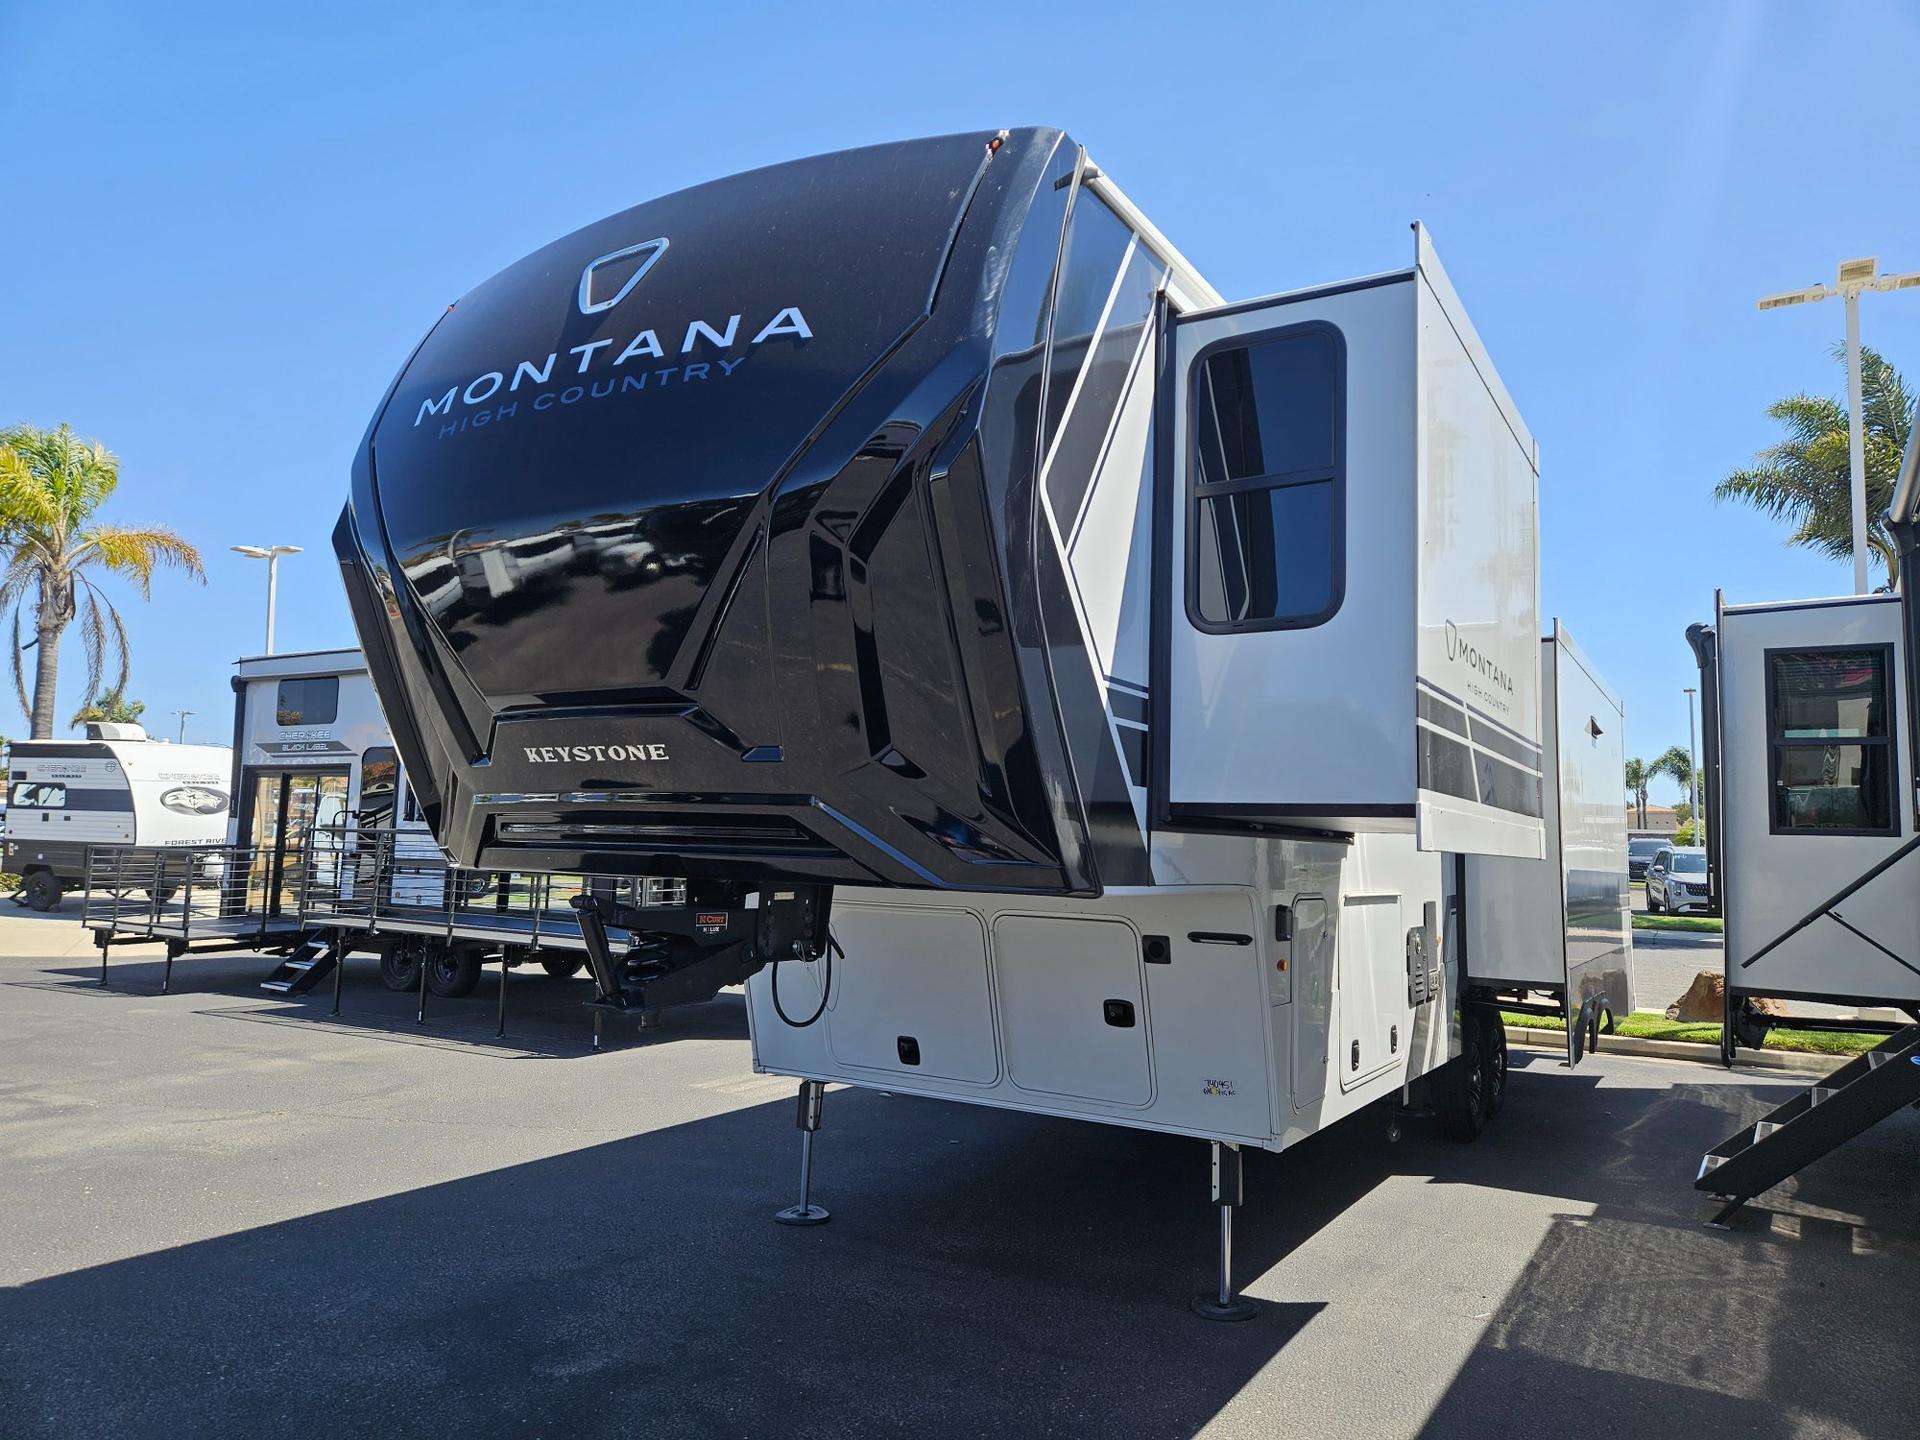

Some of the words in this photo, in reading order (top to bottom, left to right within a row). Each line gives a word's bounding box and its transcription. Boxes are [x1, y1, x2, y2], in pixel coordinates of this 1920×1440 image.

[414, 306, 813, 427] MONTANA
[438, 402, 518, 440] HIGH
[533, 357, 747, 410] COUNTRY
[1459, 637, 1514, 696] MONTANA
[306, 743, 329, 751] LABEL
[524, 744, 670, 763] KEYSTONE
